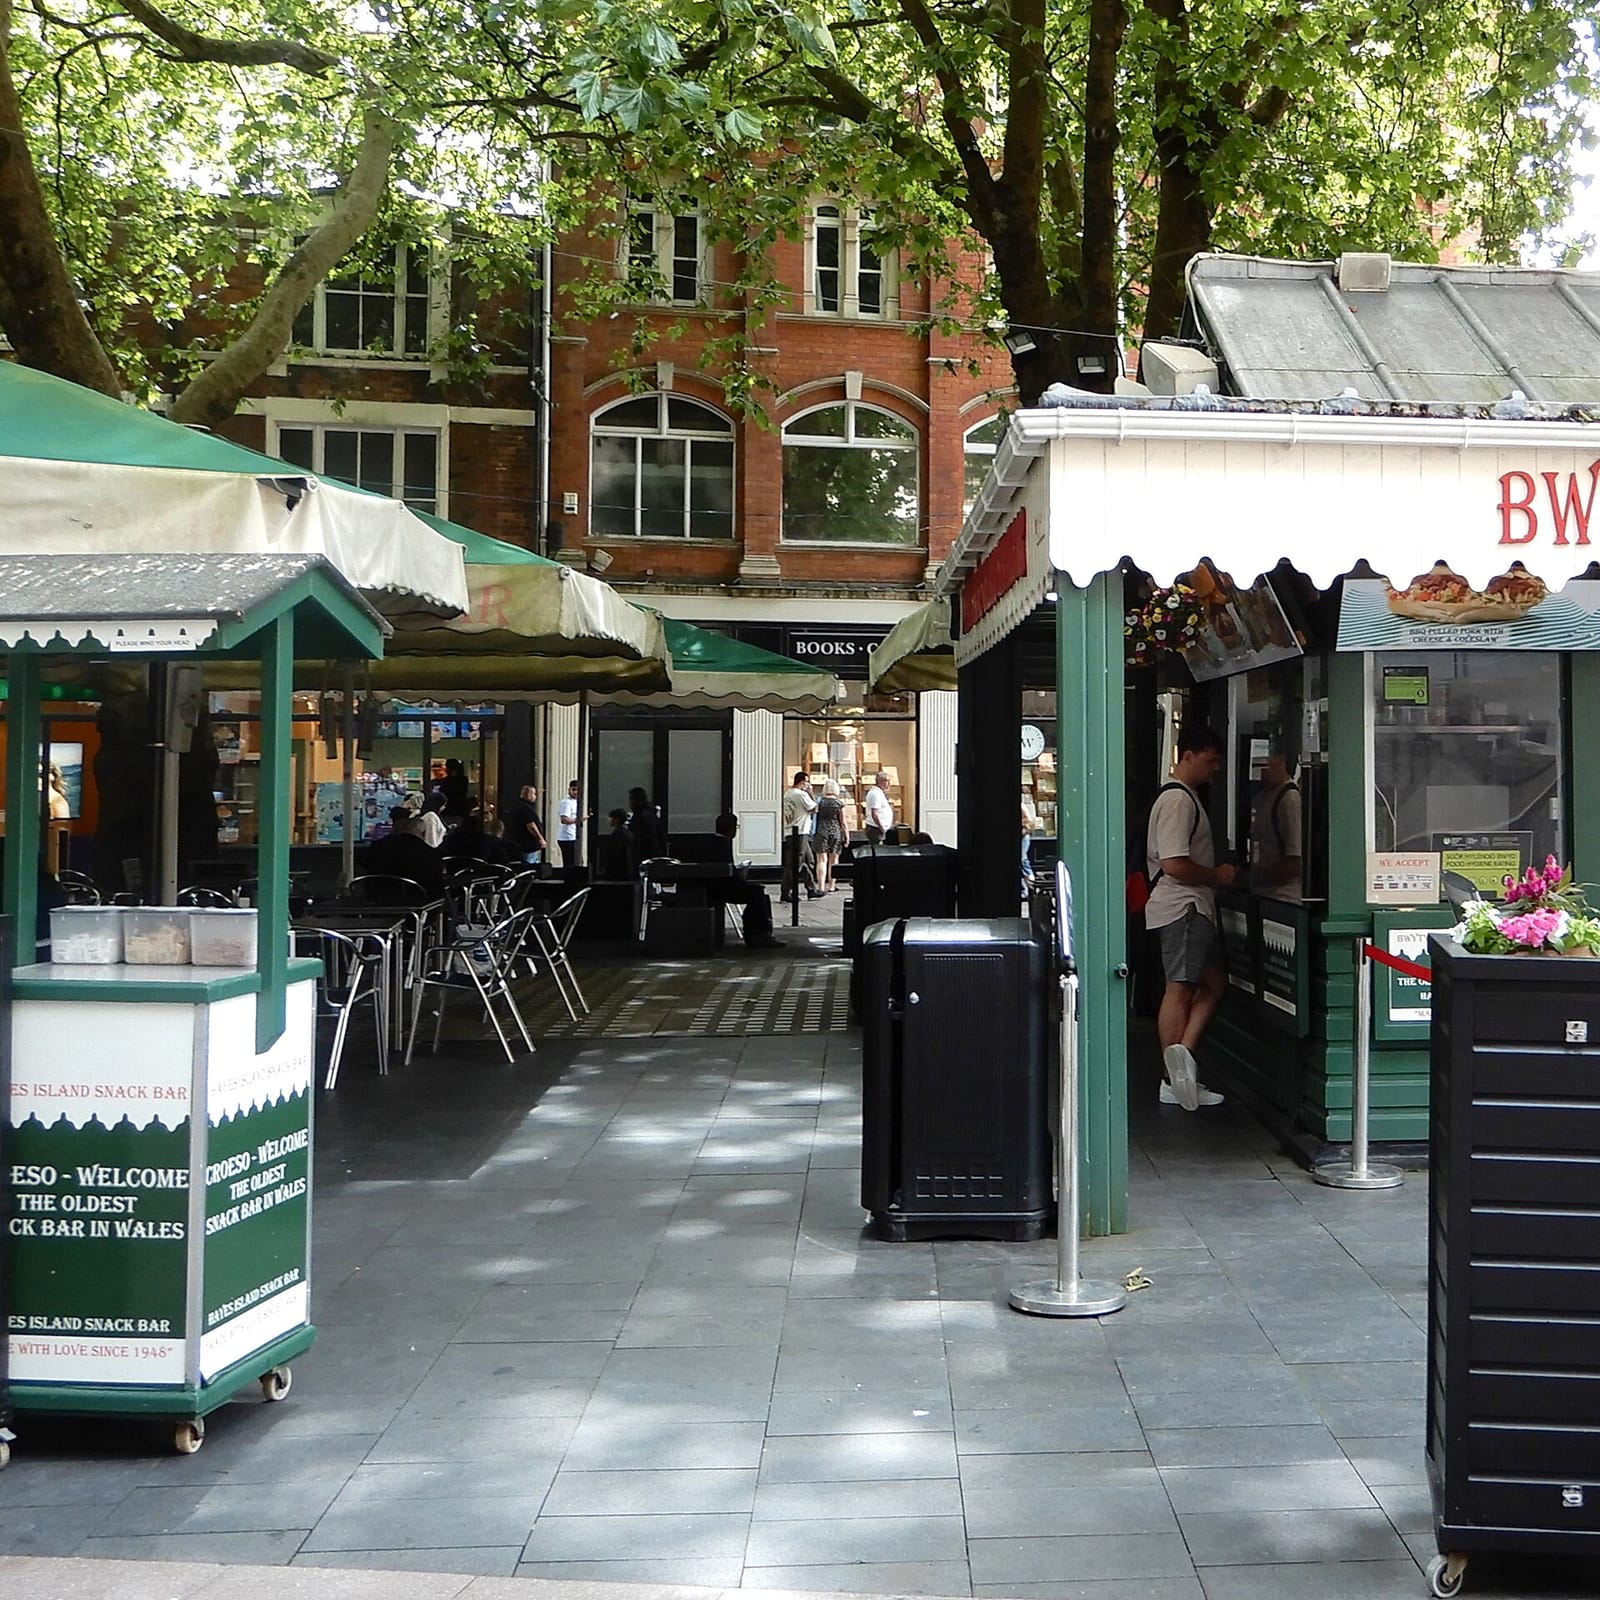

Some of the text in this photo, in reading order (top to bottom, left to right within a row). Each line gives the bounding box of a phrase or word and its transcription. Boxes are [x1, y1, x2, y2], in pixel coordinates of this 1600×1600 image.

[1496, 459, 1600, 545] BW
[796, 642, 856, 655] BOOKS
[866, 642, 880, 655] C
[1412, 636, 1444, 644] CHEESE
[1379, 858, 1431, 867] WE ACCEPT
[1446, 860, 1465, 868] FOOD
[1397, 933, 1426, 943] BWYT
[1397, 978, 1417, 986] THE
[10, 1083, 188, 1100] ES ISLAND SNACK BAR
[205, 1151, 251, 1186] CROESO
[258, 1128, 309, 1165] WELCOME
[10, 1165, 57, 1186] ESO
[76, 1163, 190, 1188] WELCOME
[229, 1163, 288, 1200] THE OLDEST
[16, 1194, 138, 1213] THE OLDEST
[205, 1177, 306, 1236] SNACK BAR IN WALES
[9, 1218, 185, 1240] CK BAR IN WALES
[8, 1315, 170, 1333] ES ISLAND SNACK BAR
[18, 1342, 50, 1356] WITH
[54, 1343, 88, 1357] LOVE
[91, 1345, 129, 1358] SINCE
